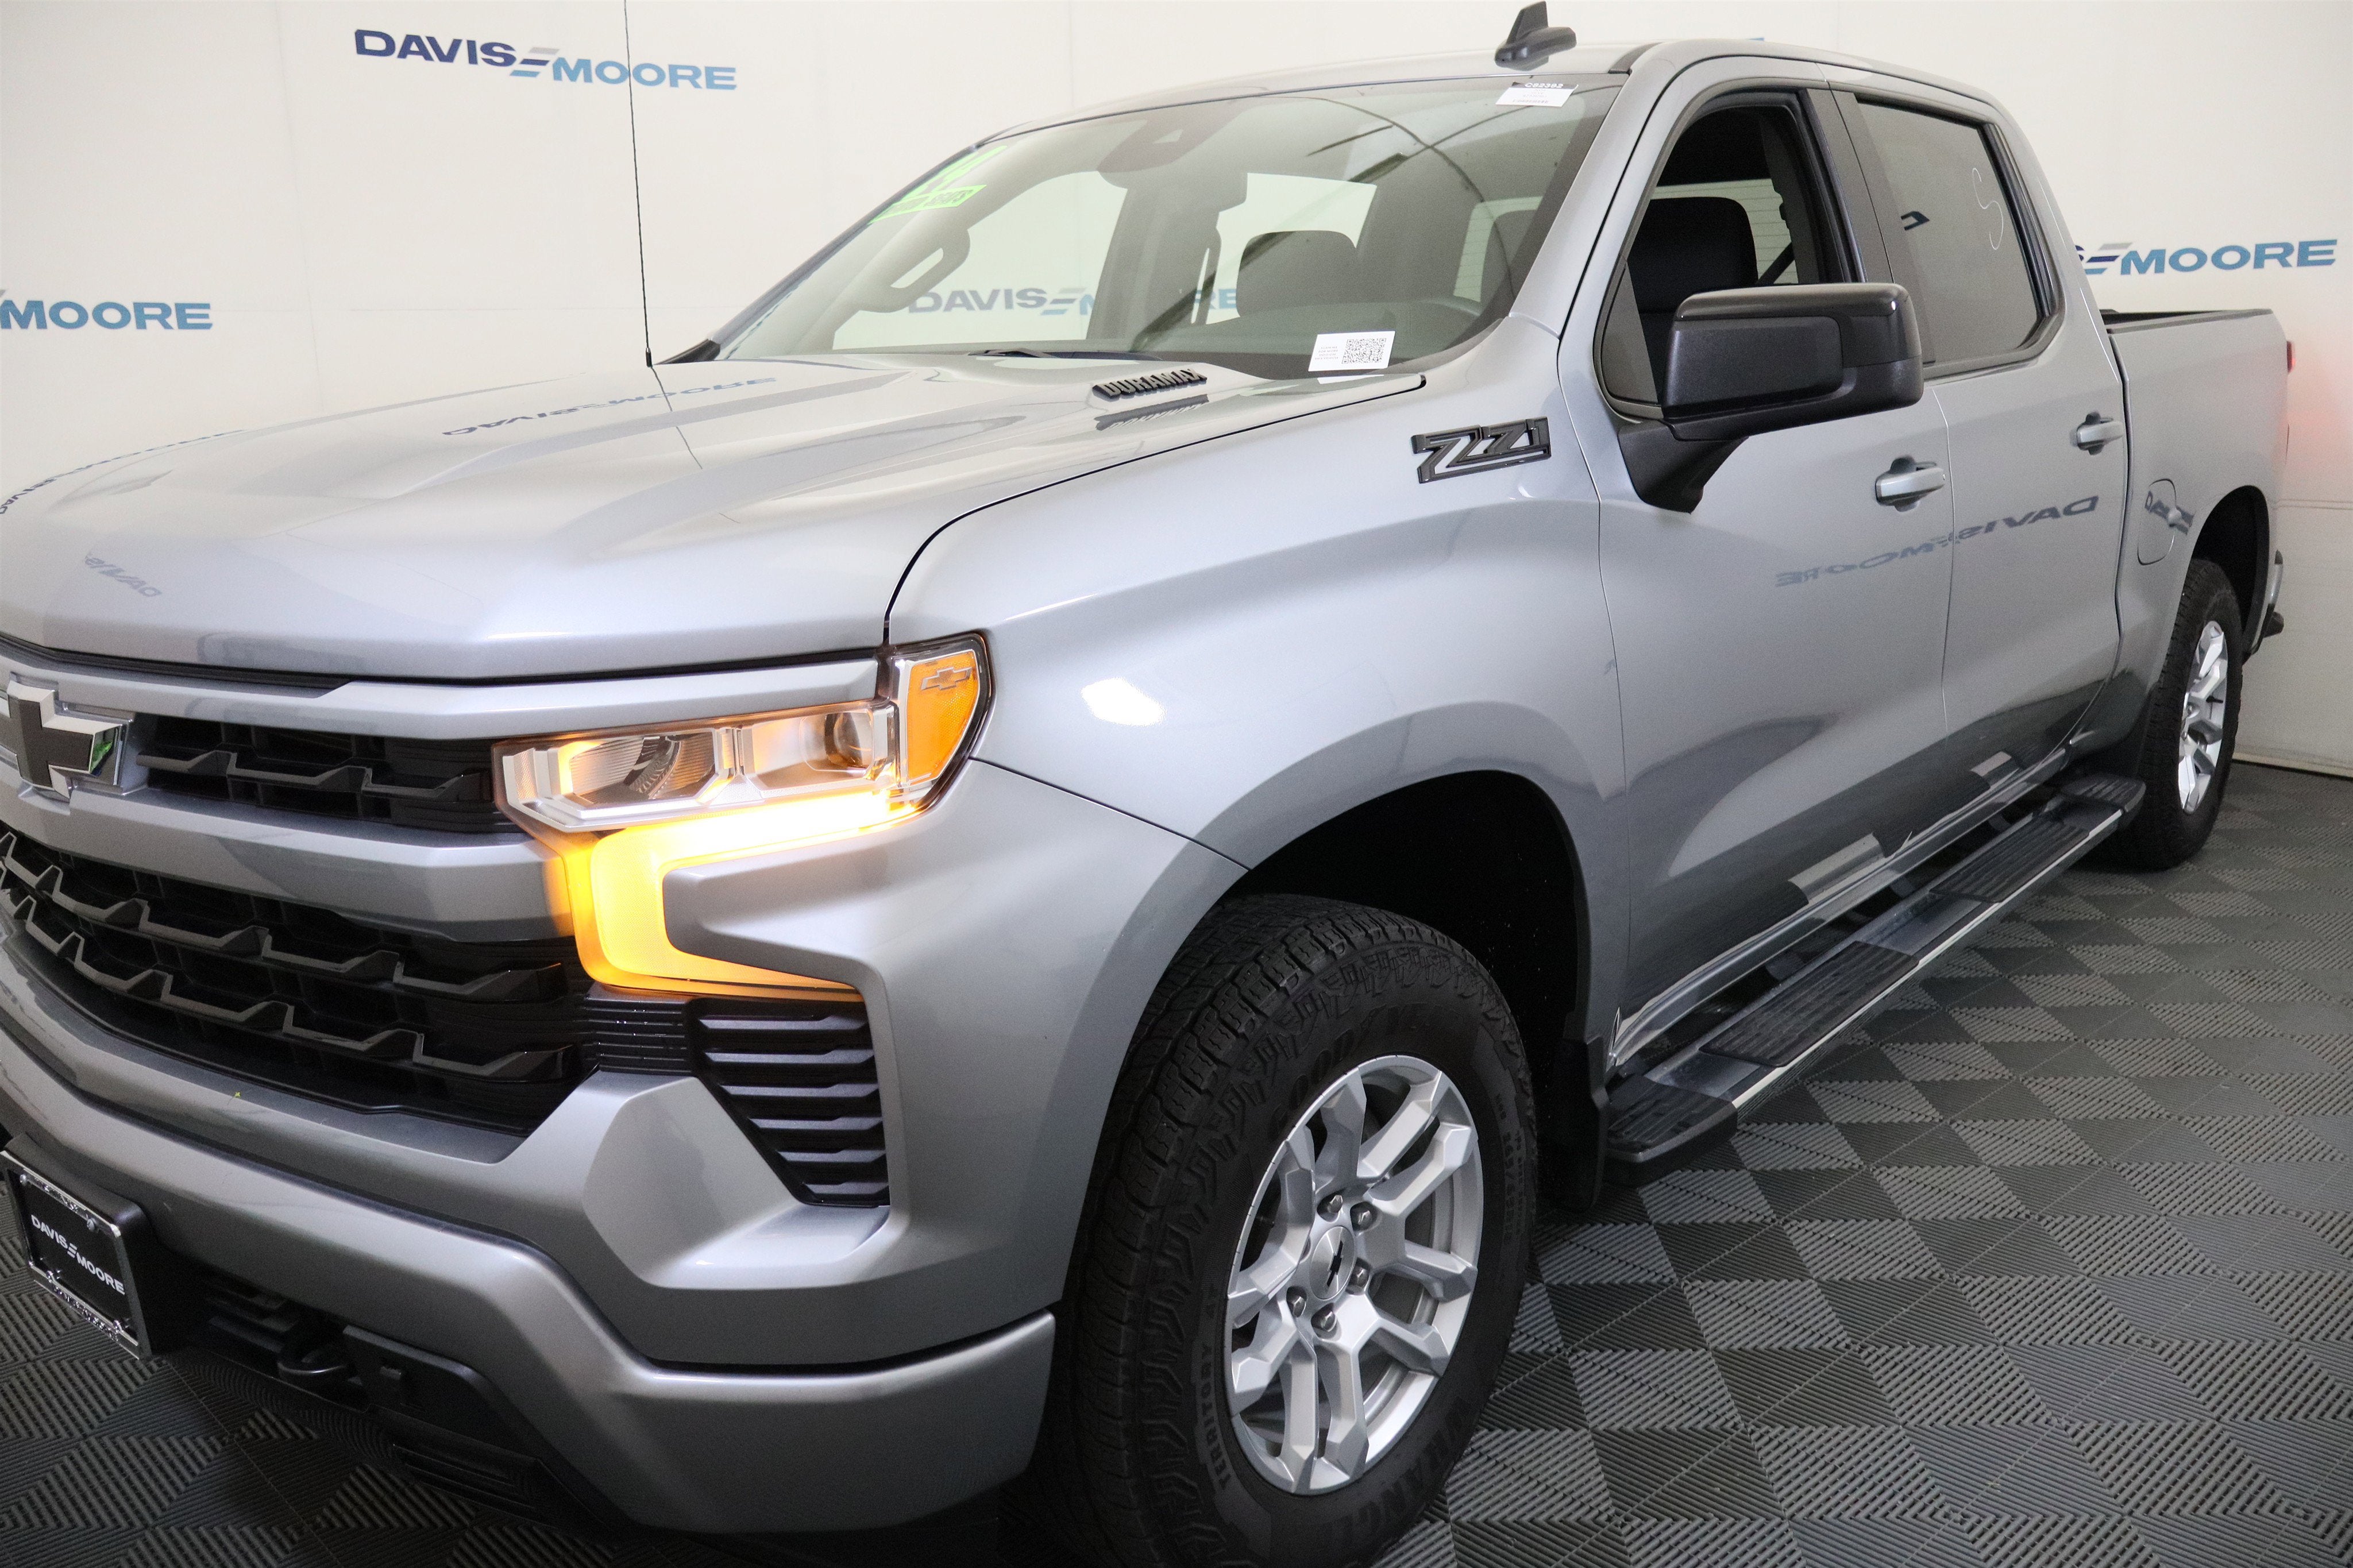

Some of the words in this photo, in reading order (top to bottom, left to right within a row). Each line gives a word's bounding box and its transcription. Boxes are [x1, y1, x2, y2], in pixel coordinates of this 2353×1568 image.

[354, 29, 516, 67] DAVIS
[552, 57, 737, 90] MOORE
[2120, 239, 2337, 276] MOORE
[0, 300, 213, 330] MOORE
[909, 288, 1047, 313] DAVIS
[1092, 368, 1208, 399] DURAMAX
[1411, 416, 1552, 484] Z71
[31, 1214, 68, 1250] DAVIS
[76, 1252, 125, 1295] MOORE
[1201, 1343, 1232, 1490] TERRITORY
